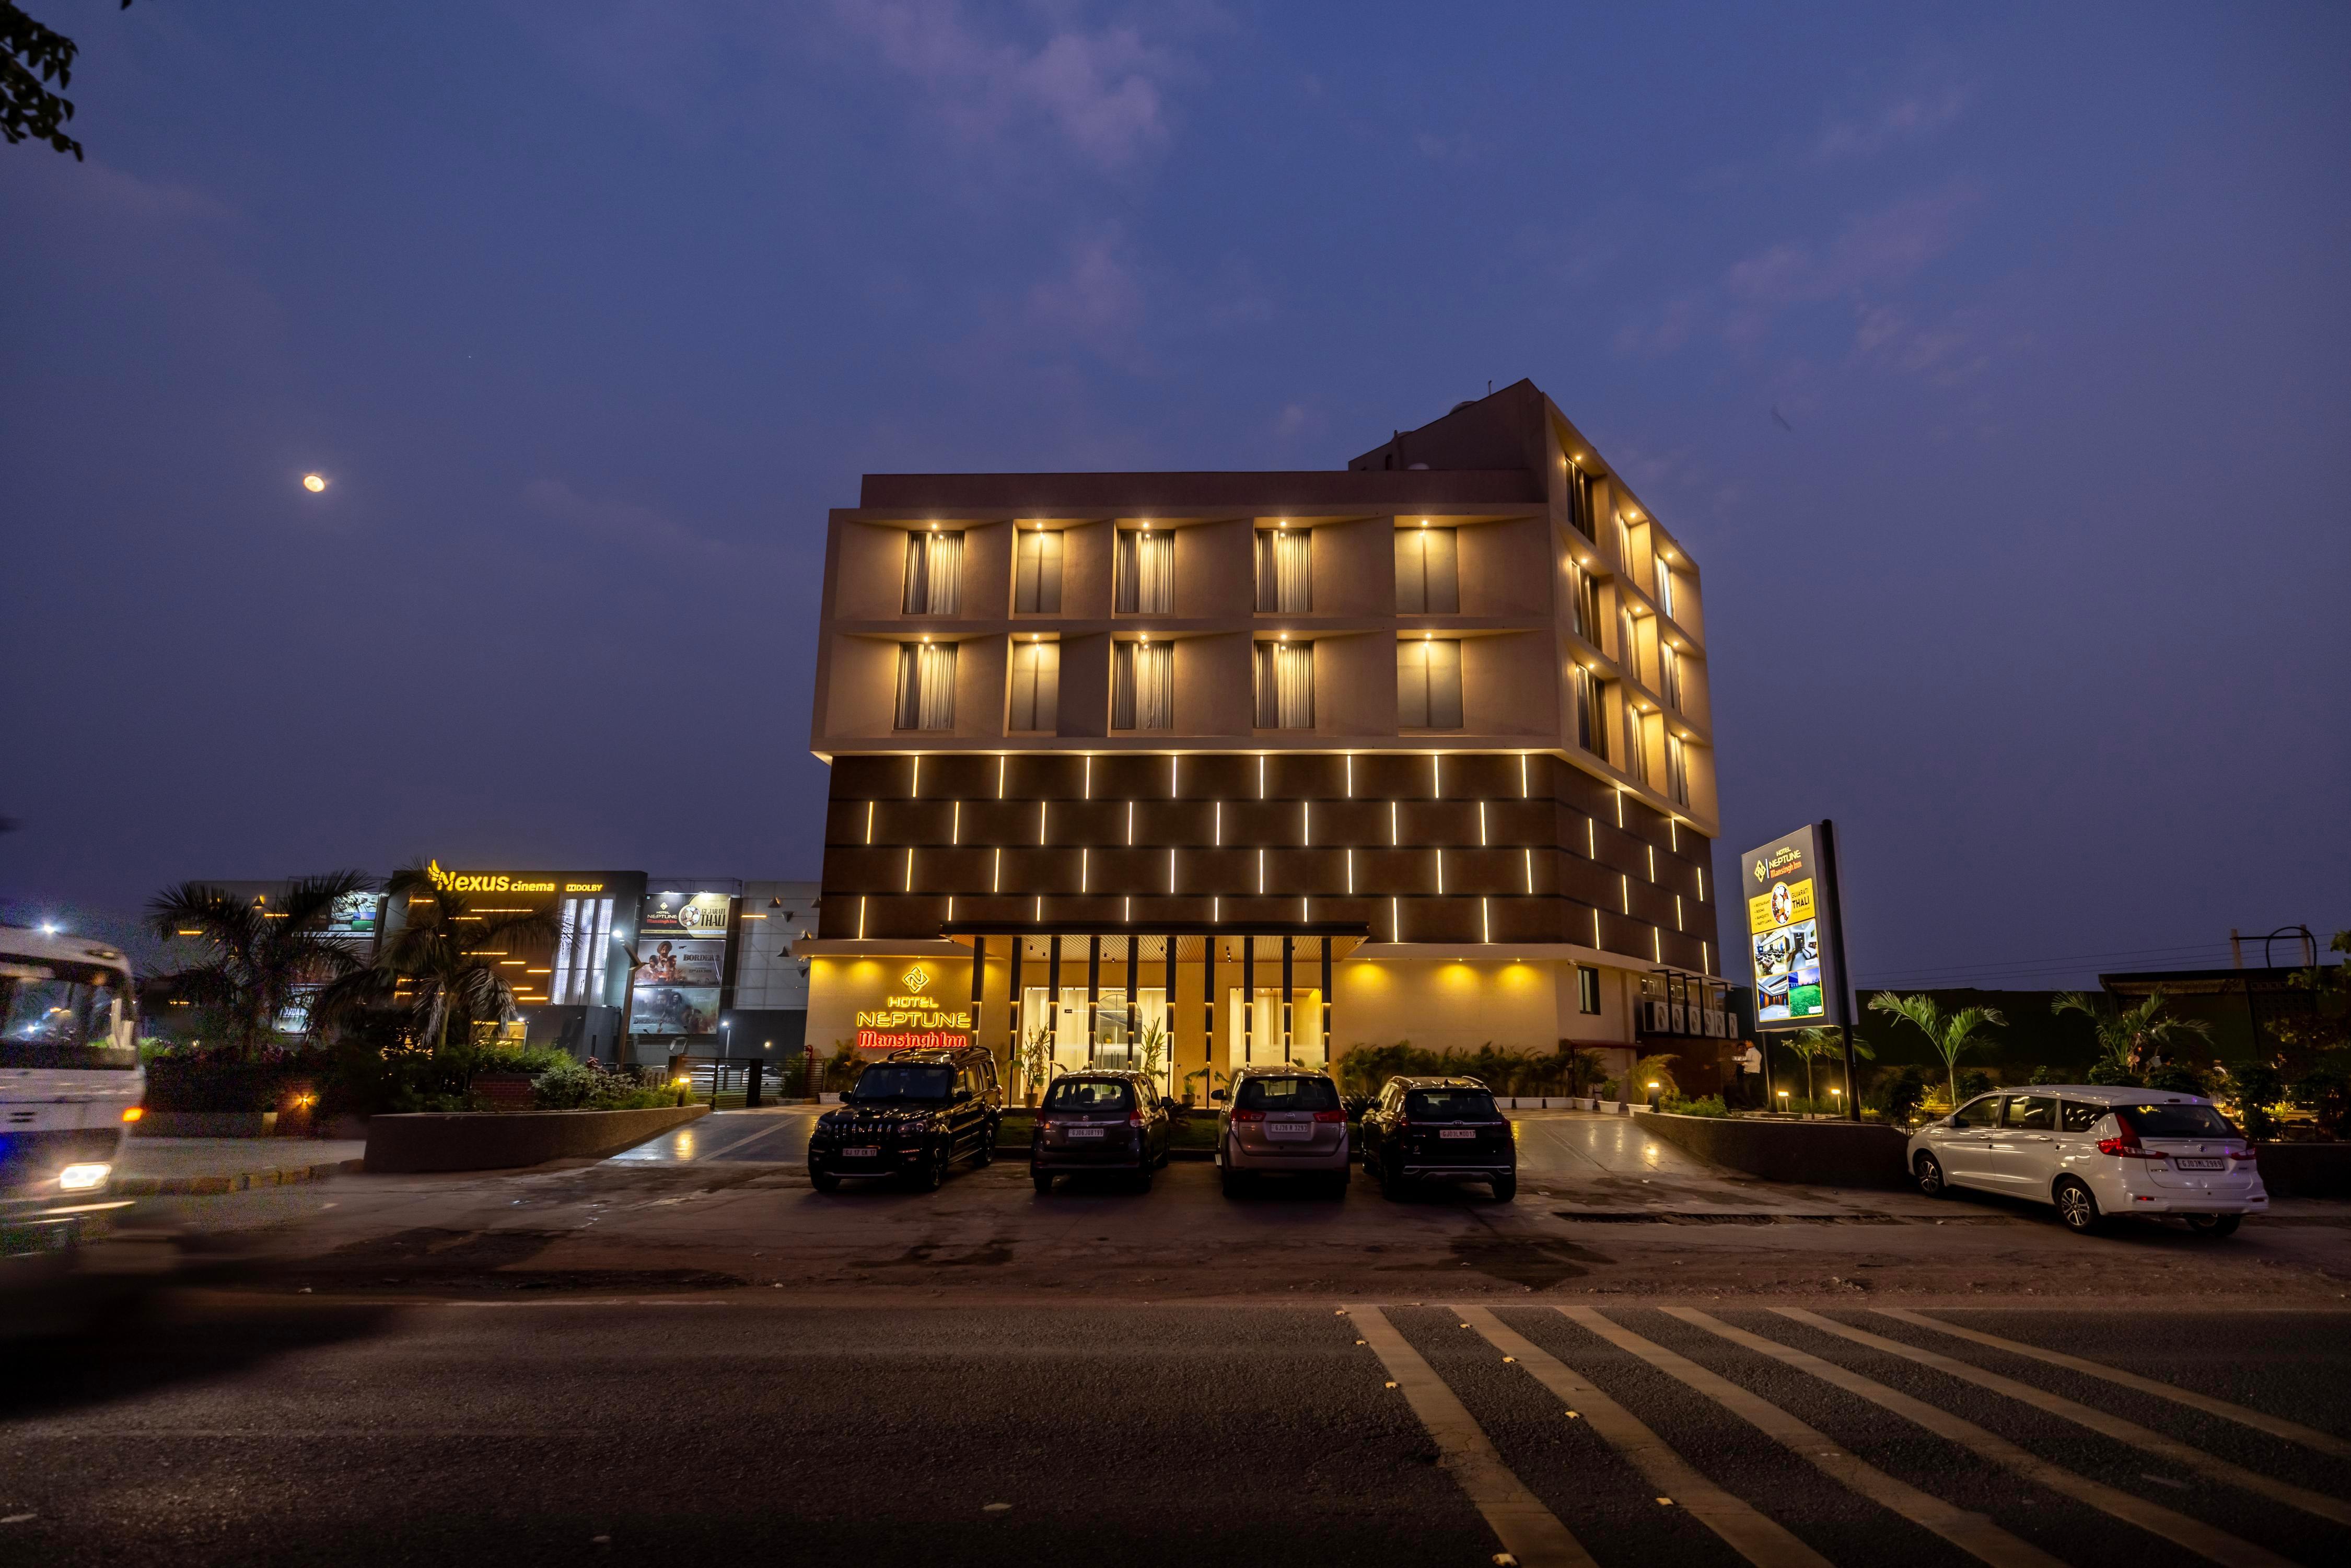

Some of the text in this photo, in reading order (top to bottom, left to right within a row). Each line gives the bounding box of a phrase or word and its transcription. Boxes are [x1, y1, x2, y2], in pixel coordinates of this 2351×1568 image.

[1776, 846, 1791, 856] HOTEL
[1768, 850, 1801, 869] NEPTUNE
[1770, 861, 1802, 878] Mansingh Inn
[437, 870, 555, 891] Nexus cinema
[1791, 888, 1809, 898] GUJARATI
[1792, 896, 1810, 909] THALI
[701, 914, 726, 926] THALI
[888, 997, 938, 1008] HOTEL
[857, 1012, 971, 1028] NEPTUNE
[859, 1031, 967, 1047] Mansingh Inn
